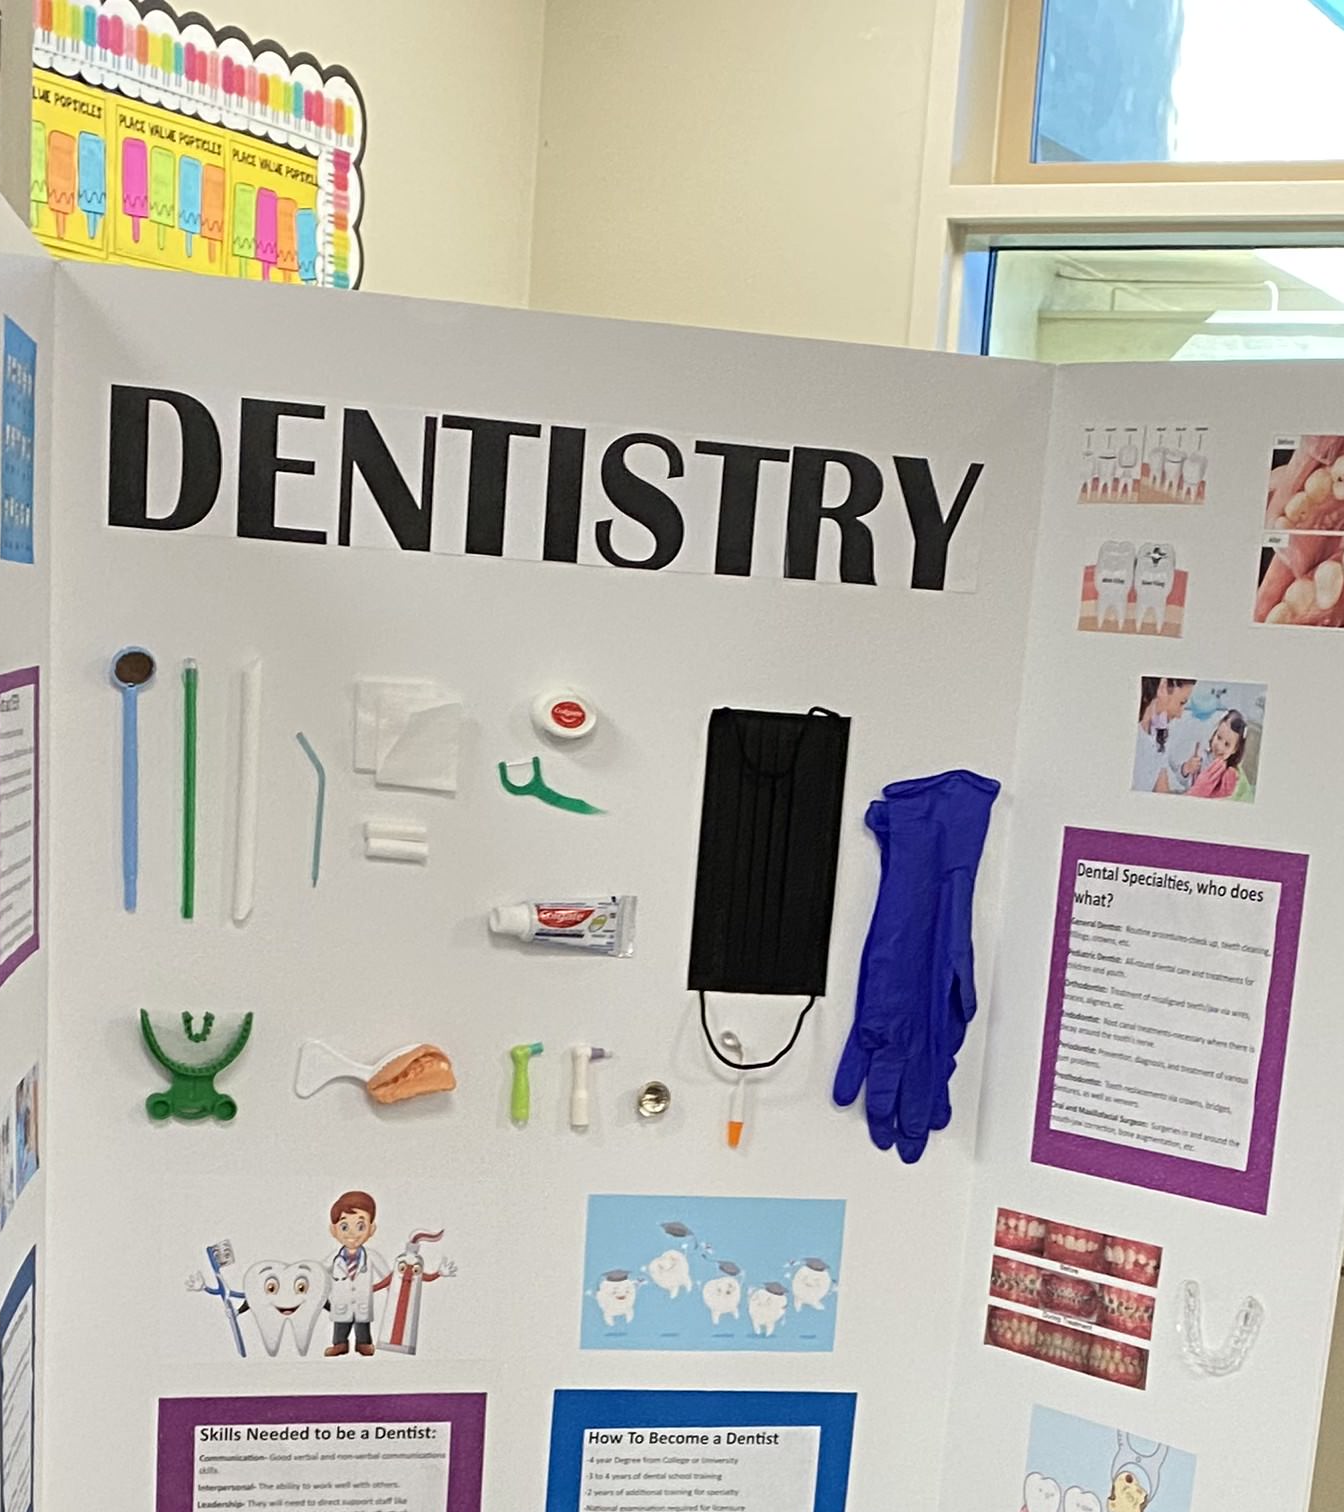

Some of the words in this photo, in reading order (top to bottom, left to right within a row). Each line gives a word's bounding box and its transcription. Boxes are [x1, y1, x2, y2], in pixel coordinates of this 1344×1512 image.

[119, 114, 145, 133] PLACE
[148, 122, 176, 142] VALUE
[179, 131, 222, 156] POPSICLES
[232, 148, 256, 167] PLACE
[259, 156, 283, 176] VALUE
[108, 384, 985, 591] DENTISTRY
[1077, 862, 1119, 881] Dental
[1121, 868, 1192, 895] Specialties,
[1197, 879, 1226, 897] who
[1230, 883, 1264, 902] does
[1074, 890, 1114, 908] what?
[200, 1427, 241, 1441] Skills
[246, 1426, 310, 1441] Needed
[315, 1428, 331, 1440] to
[336, 1426, 356, 1440] be
[360, 1430, 369, 1440] a
[375, 1426, 437, 1440] Dentist:
[588, 1431, 623, 1445] How
[627, 1431, 644, 1444] To
[649, 1431, 709, 1445] Become
[713, 1434, 721, 1445] a
[726, 1432, 779, 1445] Dentist
